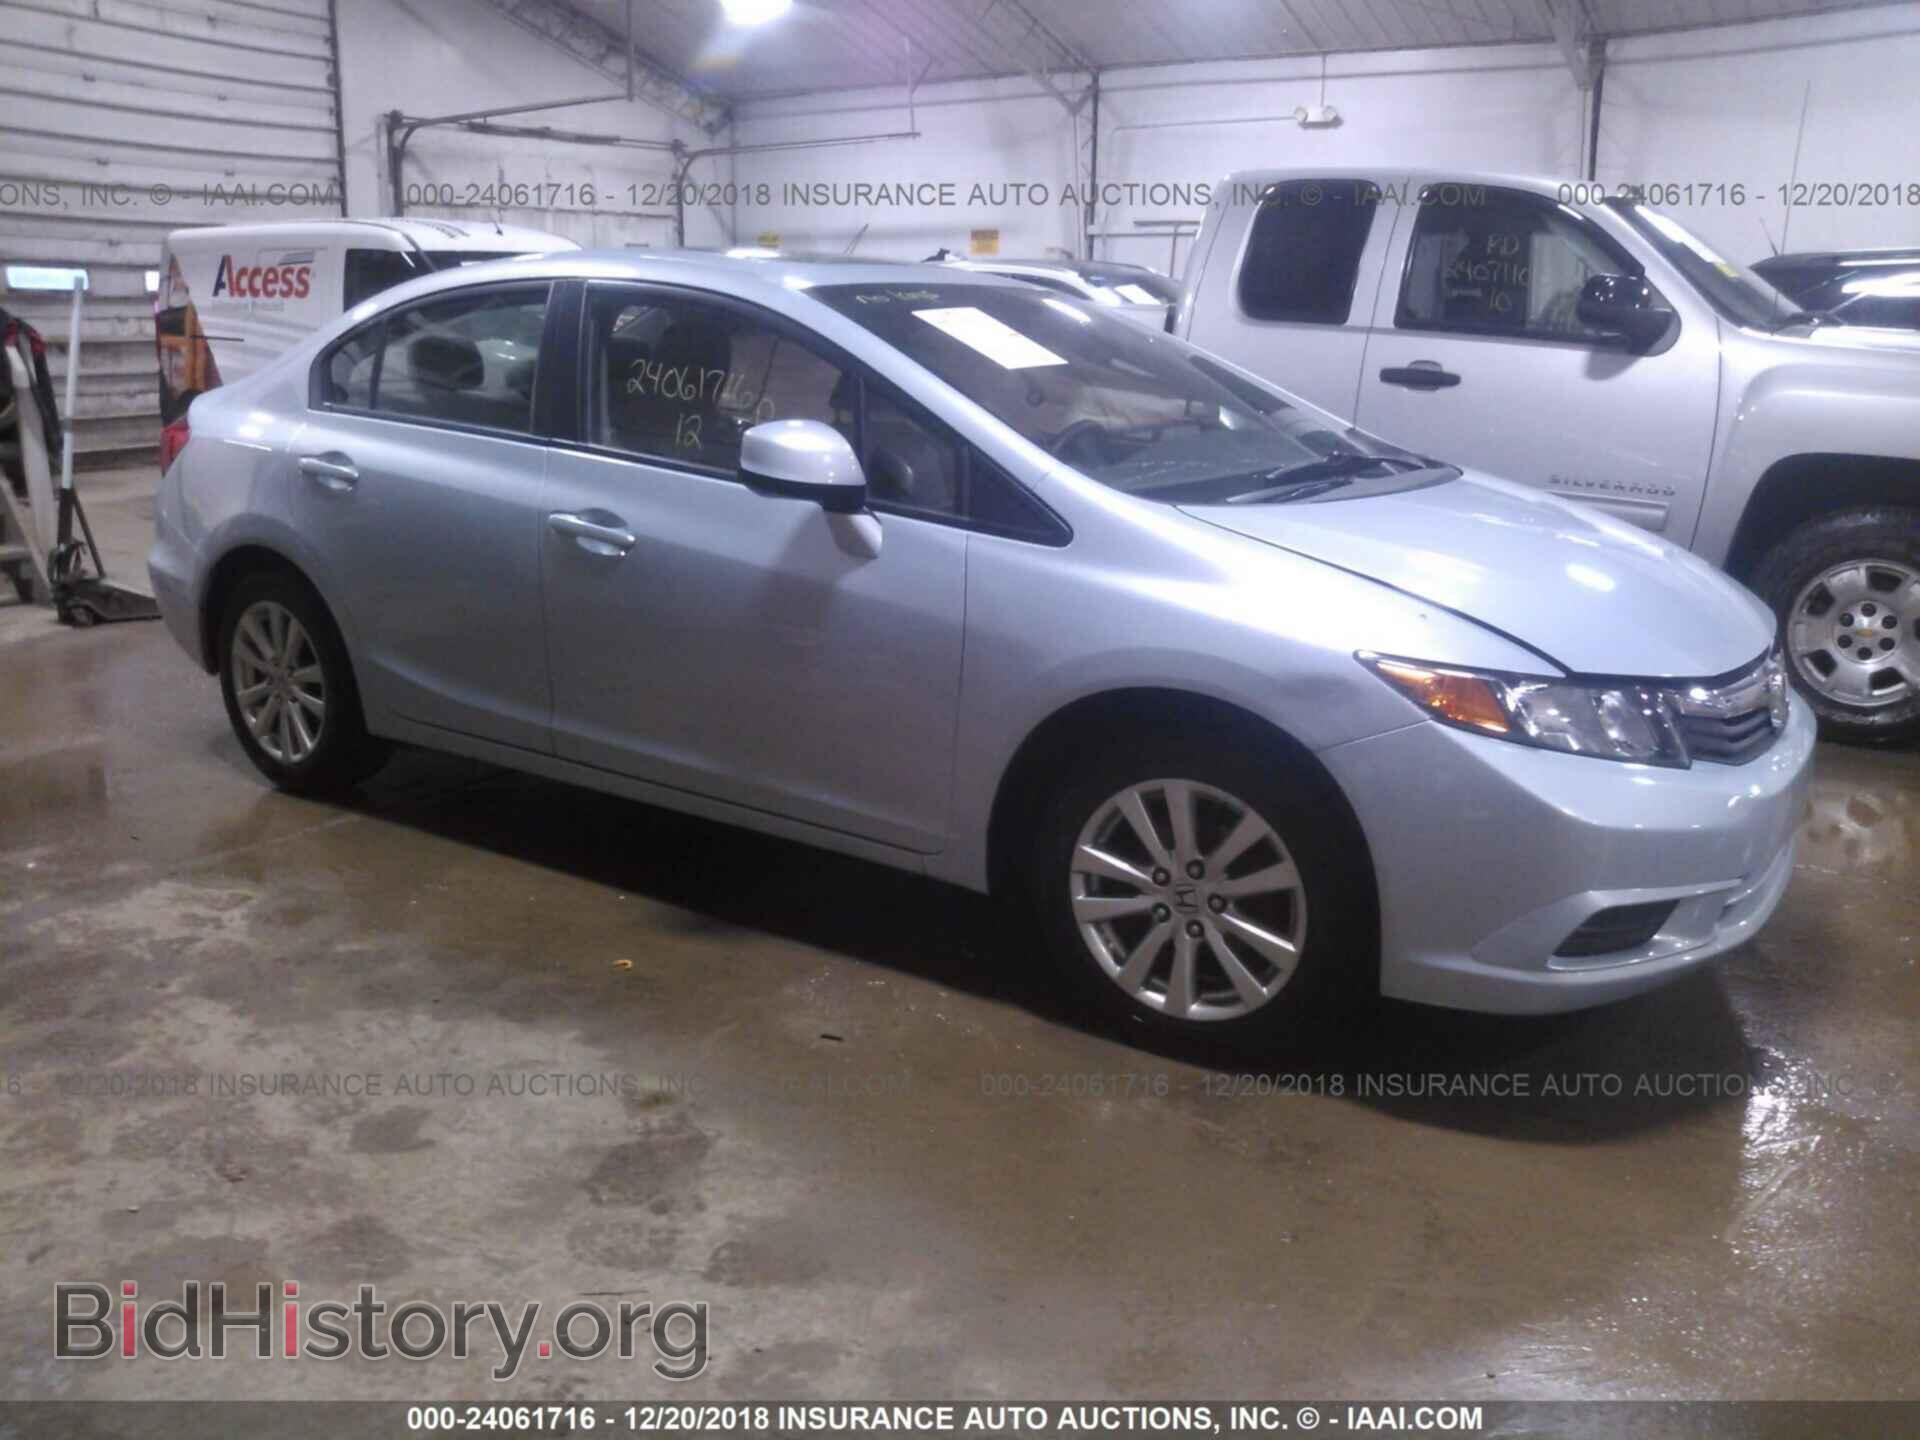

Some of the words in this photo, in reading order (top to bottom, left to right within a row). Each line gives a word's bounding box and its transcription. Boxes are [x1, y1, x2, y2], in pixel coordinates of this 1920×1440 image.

[212, 254, 312, 299] Access
[674, 411, 703, 450] 12
[1548, 473, 1677, 497] SILVERADO
